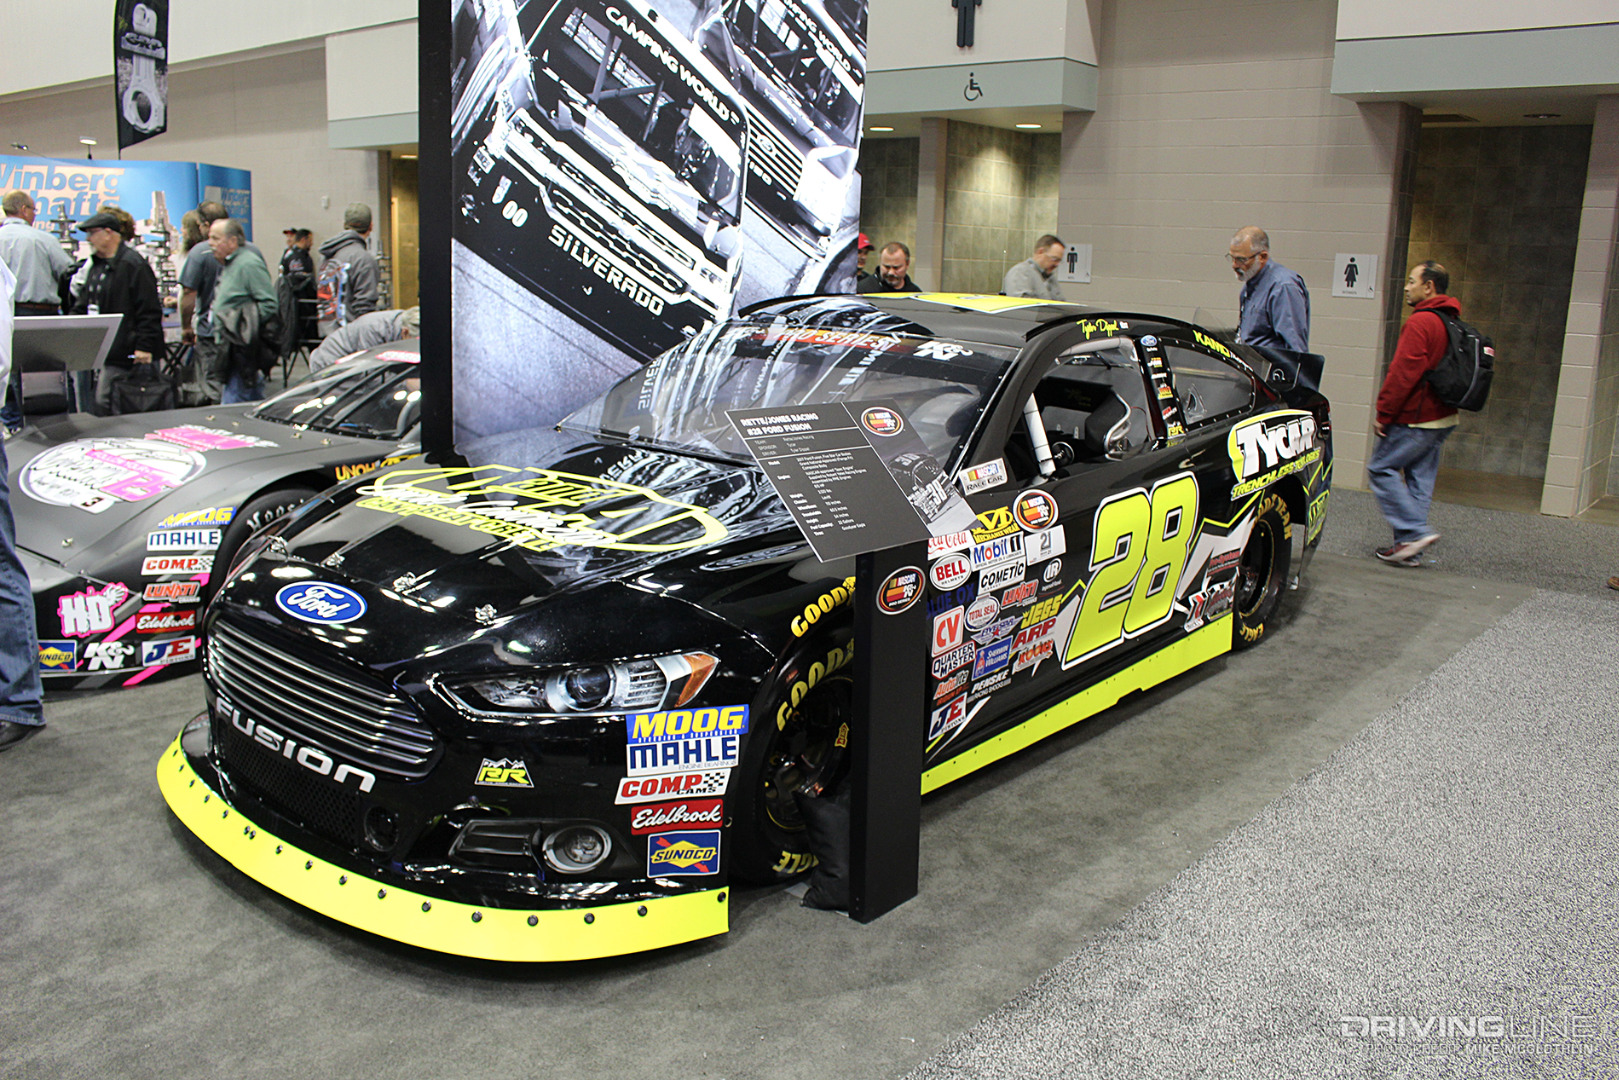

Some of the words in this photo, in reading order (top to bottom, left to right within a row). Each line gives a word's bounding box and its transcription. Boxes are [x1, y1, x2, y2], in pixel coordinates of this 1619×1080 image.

[605, 6, 677, 79] CAMPING
[677, 70, 731, 121] WORLD
[548, 223, 664, 316] SILVERADO
[815, 331, 893, 349] SERIES
[911, 341, 973, 361] K&N
[739, 415, 792, 426] RETTE/JONES
[789, 412, 819, 421] RACING
[760, 425, 785, 434] FORD
[782, 422, 813, 432] FUSION
[1233, 461, 1294, 498] TRENCHLESS
[163, 508, 233, 525] MOOG
[150, 532, 218, 546] MAHLE
[974, 538, 1007, 564] Mobil
[1010, 535, 1021, 552] 1
[146, 558, 198, 570] COMP
[936, 561, 966, 581] BELL
[981, 562, 1024, 589] COMETIC
[1065, 471, 1199, 669] 28
[146, 584, 197, 599] LUNATI
[1002, 581, 1037, 609] LUNATI
[288, 585, 353, 624] Ford
[1020, 594, 1063, 630] JEGS
[136, 613, 195, 630] Edelbrock
[936, 613, 961, 654] CV
[1012, 617, 1057, 651] ARP
[84, 642, 135, 670] K&N
[145, 639, 193, 664] JE
[933, 643, 975, 675] QUARTER
[940, 653, 975, 678] MASTER
[971, 669, 1009, 694] PENSKE
[632, 706, 745, 739] MOOG
[930, 695, 966, 738] JE
[213, 699, 377, 793] FUSION
[629, 736, 737, 770] MAHLE
[678, 762, 704, 771] ENGINE
[705, 758, 737, 769] BEARINGS
[621, 774, 703, 798] COMP
[676, 786, 717, 796] CAMS
[632, 804, 722, 829] Edelbrock
[655, 848, 715, 862] SUNOCO
